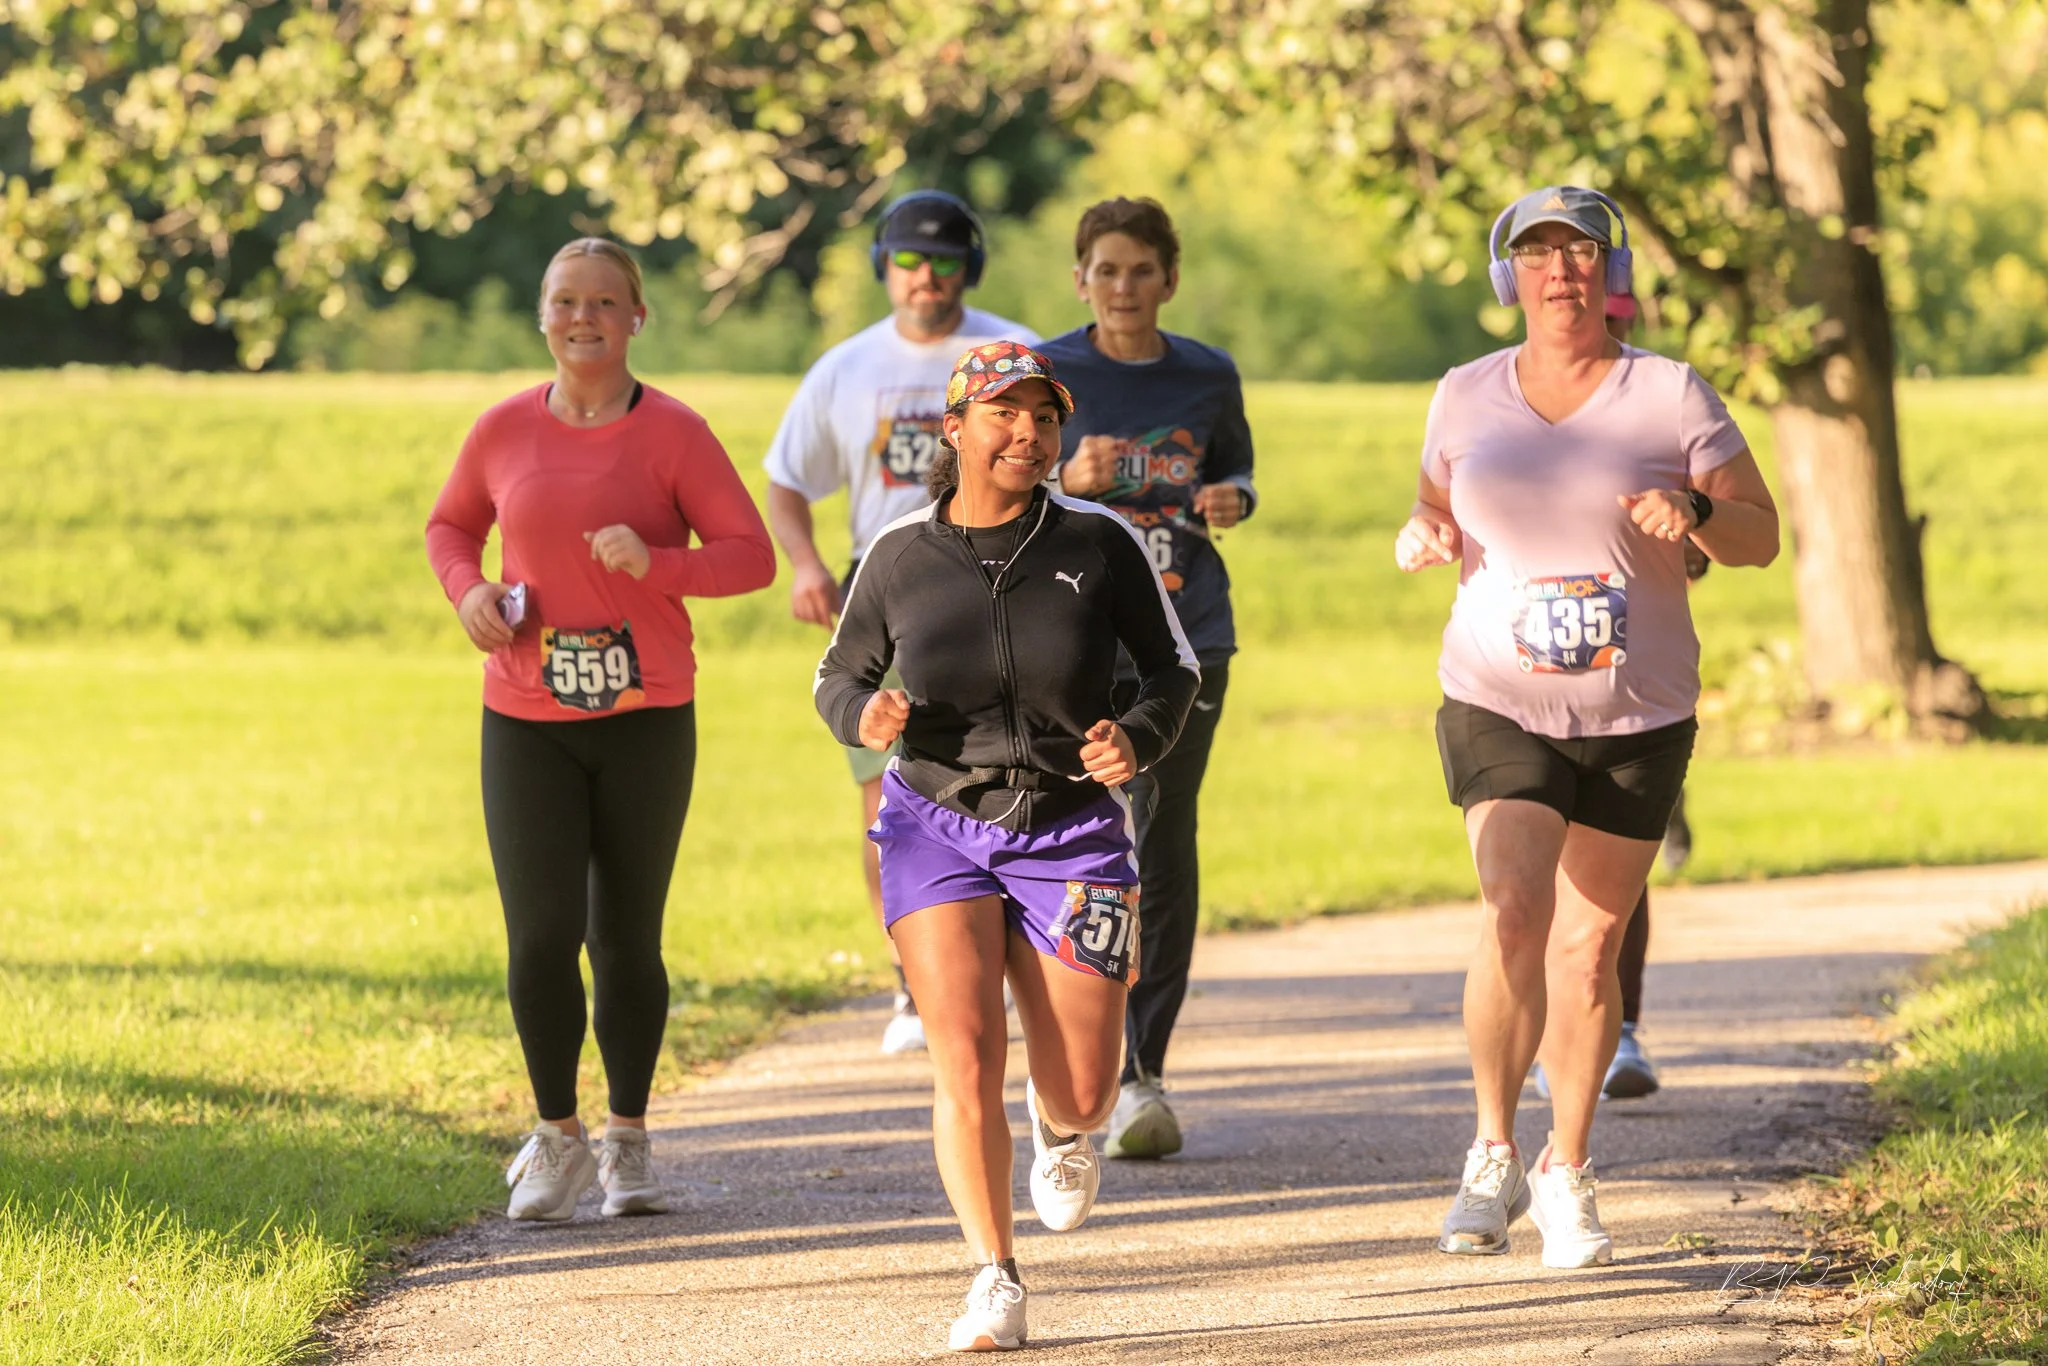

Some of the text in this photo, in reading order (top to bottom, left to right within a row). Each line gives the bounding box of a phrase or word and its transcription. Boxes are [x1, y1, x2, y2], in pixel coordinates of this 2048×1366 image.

[888, 431, 939, 475] 52
[1524, 597, 1612, 651] 435
[552, 646, 630, 695] 559
[1106, 960, 1120, 974] 5K
